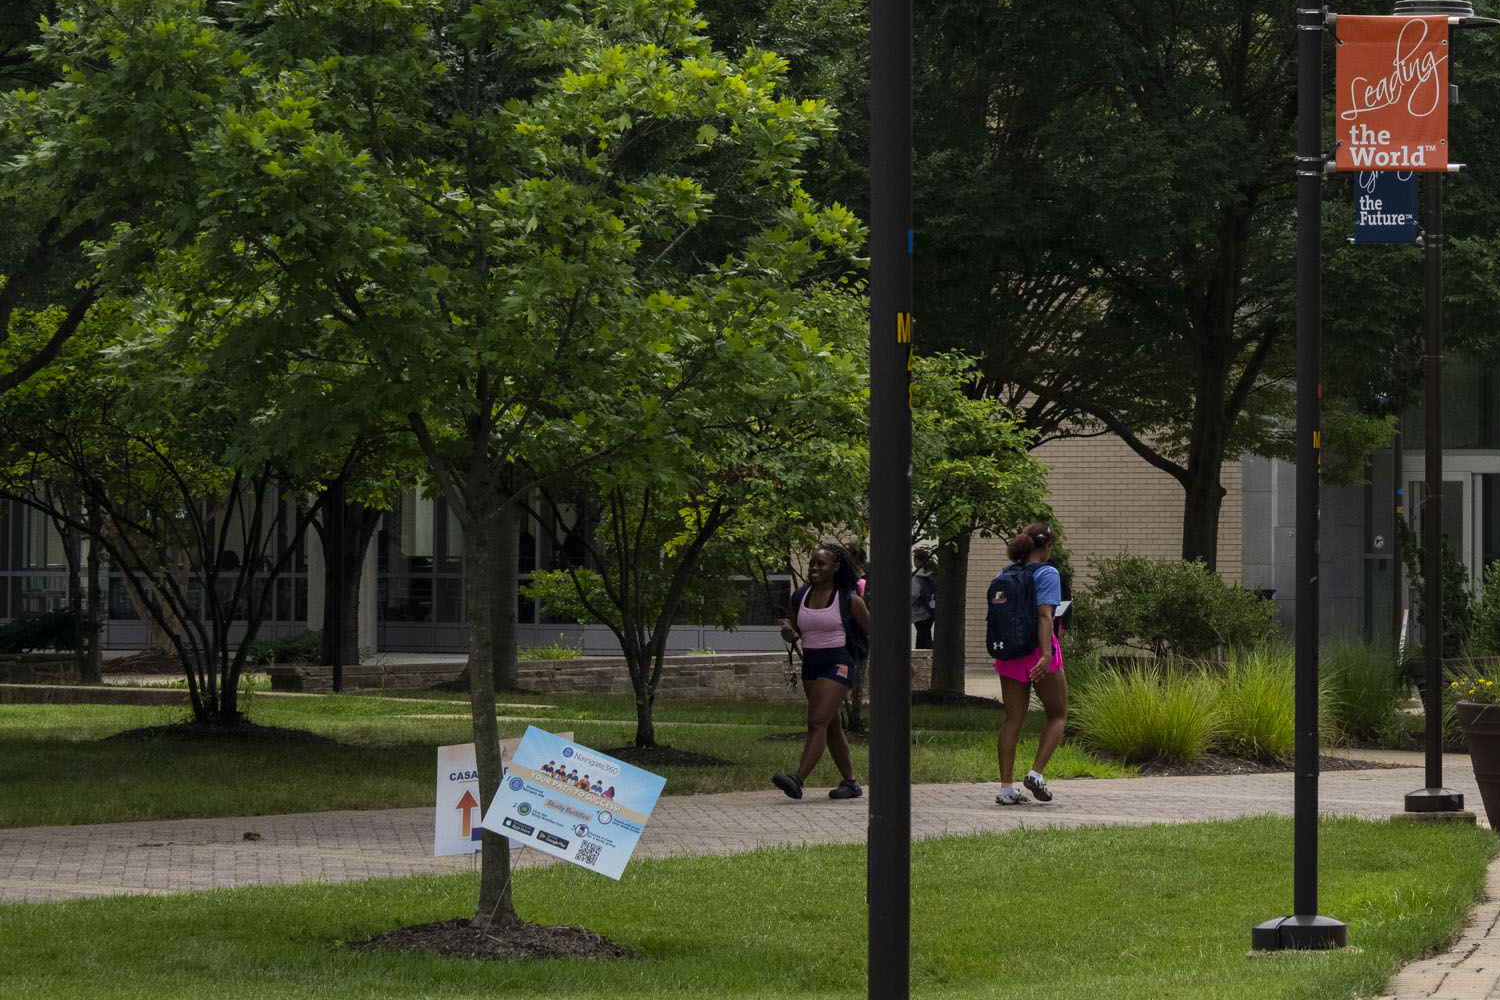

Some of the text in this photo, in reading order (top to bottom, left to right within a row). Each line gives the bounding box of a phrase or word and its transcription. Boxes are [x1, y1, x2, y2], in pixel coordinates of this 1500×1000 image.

[1340, 18, 1449, 120] Leading
[1349, 124, 1390, 145] the
[1359, 195, 1383, 211] the
[574, 752, 618, 775] Navigate360
[449, 770, 479, 781] CASA
[532, 773, 622, 811] YOUR PATH TO SUCCESS!
[547, 800, 590, 821] Study Buddies
